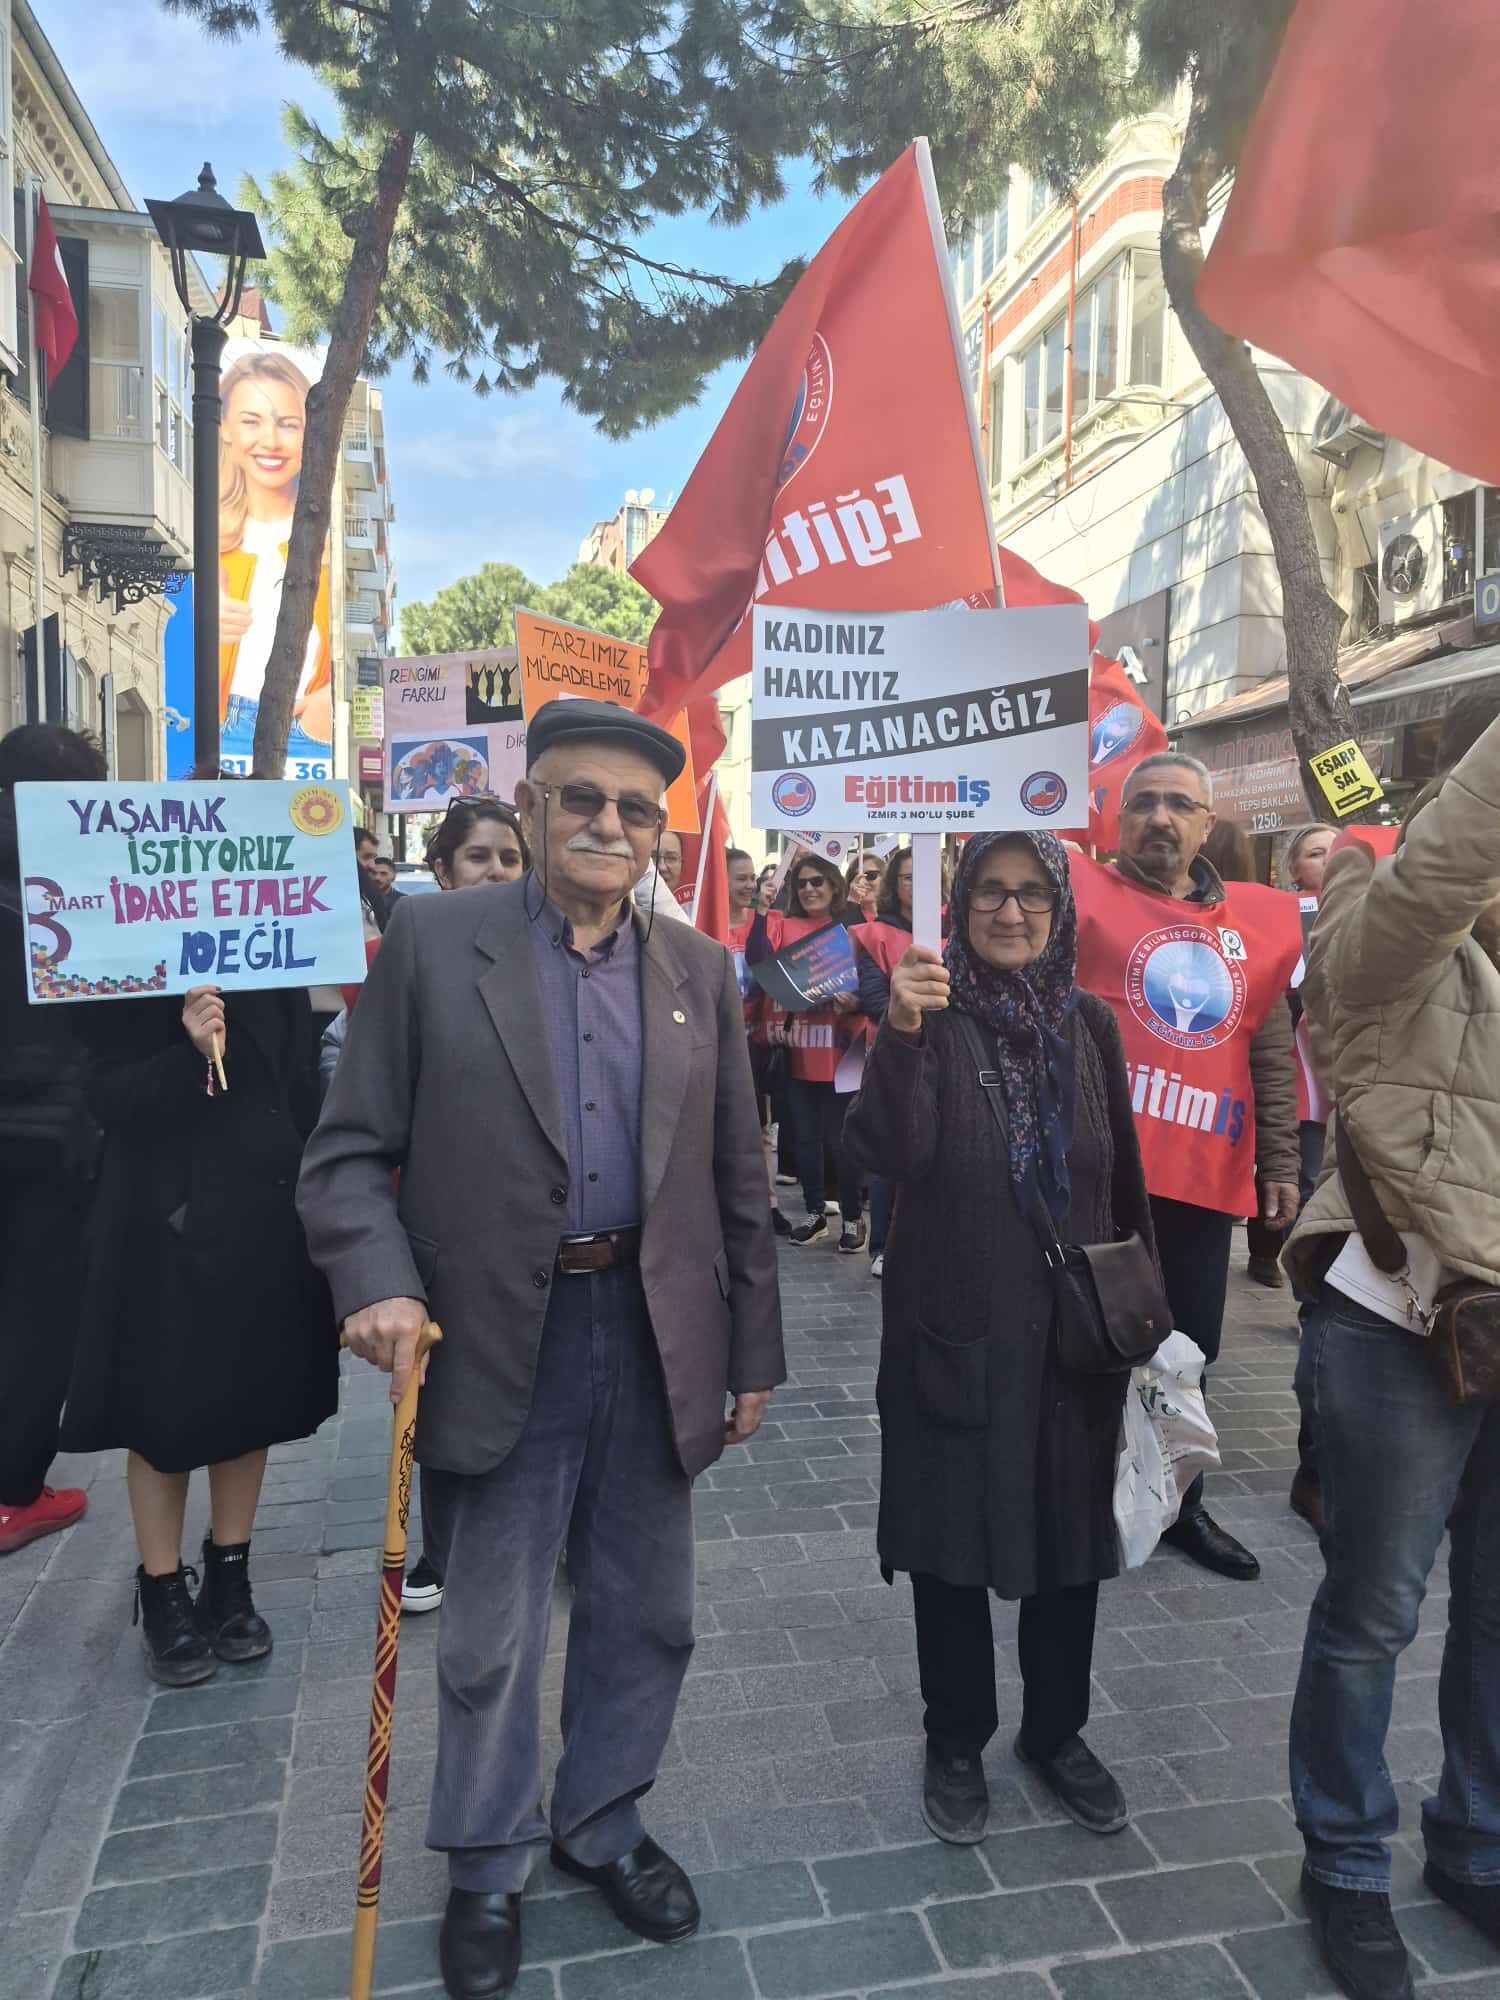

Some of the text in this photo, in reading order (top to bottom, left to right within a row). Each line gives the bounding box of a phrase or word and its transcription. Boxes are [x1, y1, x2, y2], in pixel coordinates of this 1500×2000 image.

[534, 626, 650, 676] TARZIMIZ F
[764, 620, 885, 655] KADINIZ
[526, 655, 632, 697] MÜCADELEMİZ
[764, 666, 899, 701] HAKLIYIZ
[401, 686, 446, 703] FARKLI
[782, 688, 1056, 764] KAZANACAĞIZ
[295, 762, 327, 780] 36
[1316, 747, 1357, 777] EŞARP
[844, 775, 990, 807] Eğitimiş
[1333, 770, 1361, 793] ŞAL
[68, 797, 227, 837] YAŞAMAK
[900, 811, 907, 819] 3
[909, 811, 943, 819] NO'LU
[946, 810, 975, 820] ŞUBE
[128, 834, 295, 875] İSTİYORUZ
[49, 894, 105, 911] MART
[110, 875, 333, 924] İDARE ETMEK
[179, 920, 317, 976] DEĞİL
